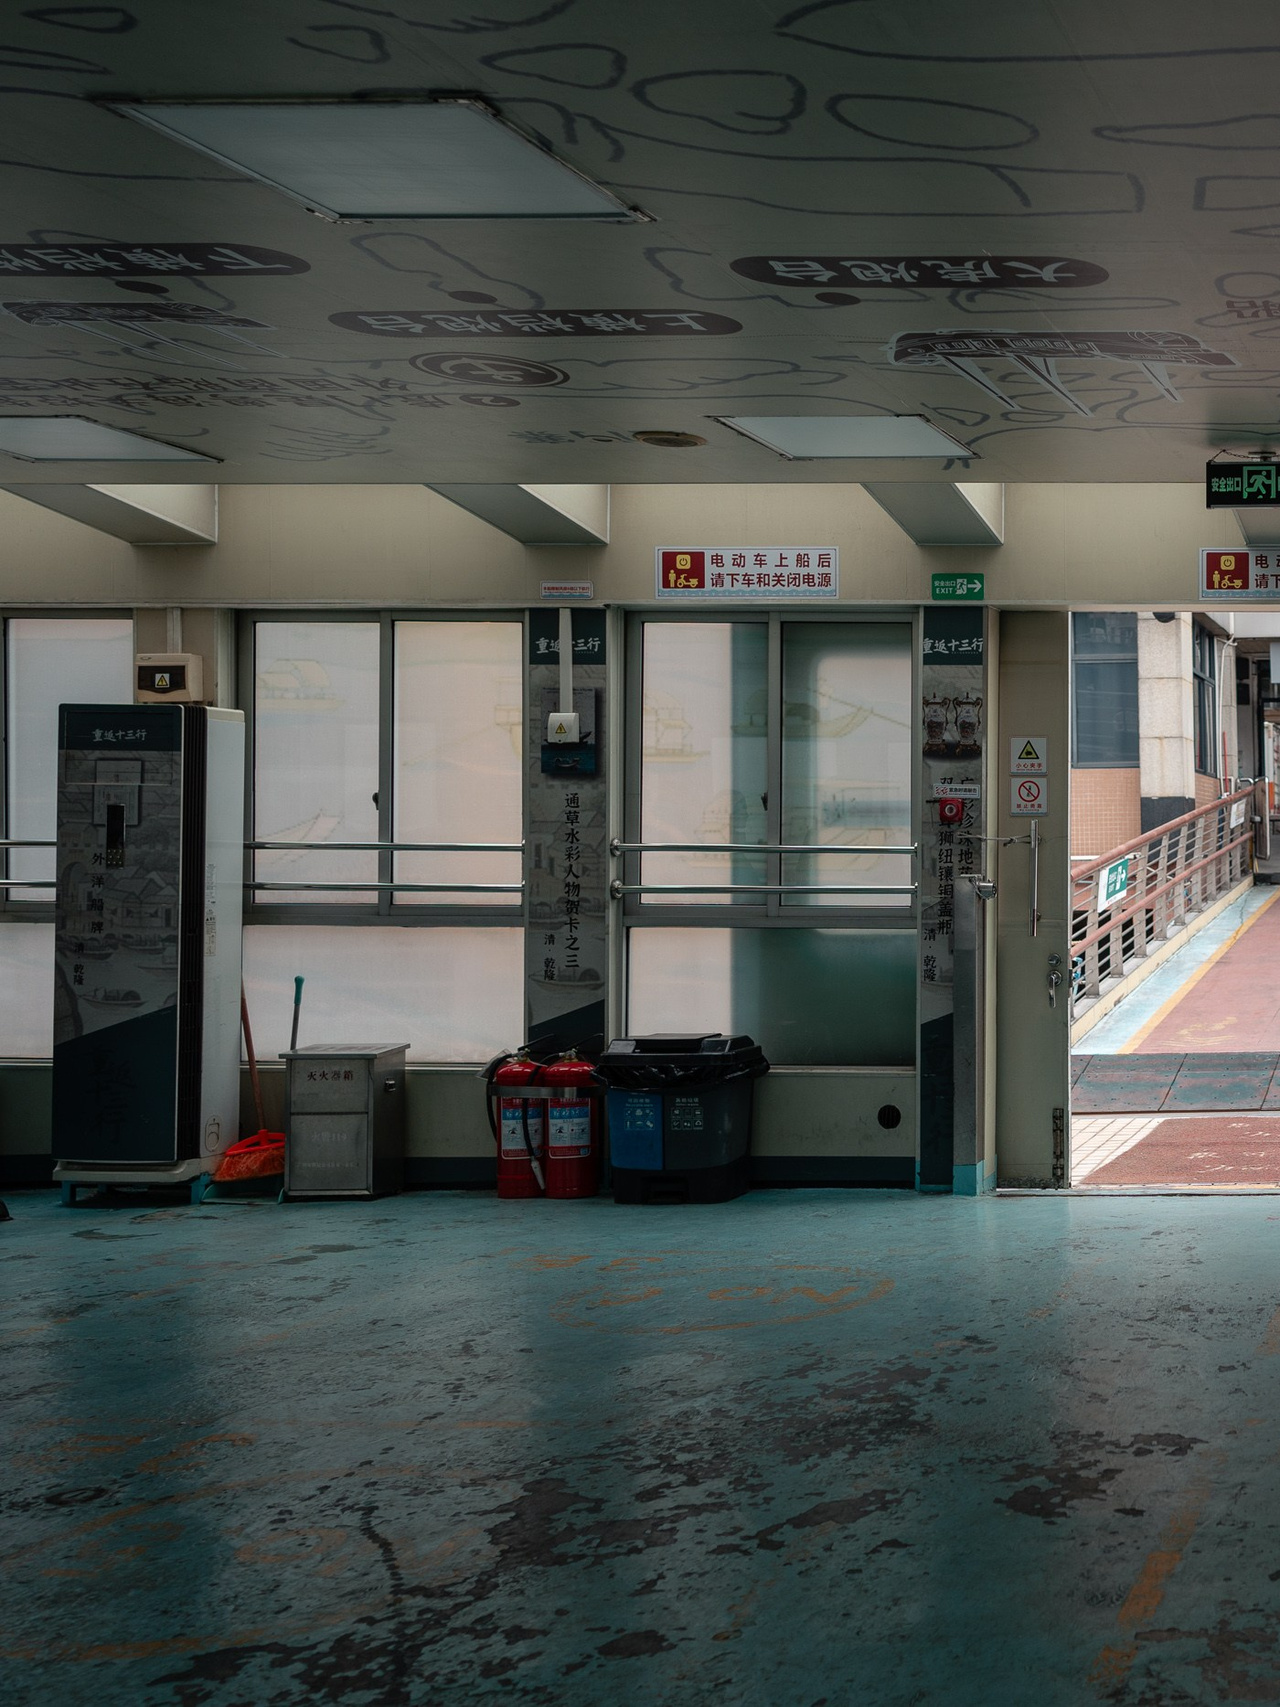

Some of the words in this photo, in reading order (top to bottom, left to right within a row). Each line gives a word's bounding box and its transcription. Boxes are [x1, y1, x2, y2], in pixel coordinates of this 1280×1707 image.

[768, 260, 1076, 283] 大虎炮台
[357, 313, 707, 333] 上横档炮台
[1211, 477, 1242, 492] 安全出口
[710, 553, 831, 569] 电动车上船后
[710, 572, 831, 589] 请下车和关闭电源
[935, 587, 954, 595] EXIT
[535, 637, 601, 654] 重返三行
[923, 637, 984, 654] 重返十三行
[564, 793, 580, 968] 通草水彩人物贺卡之三
[91, 852, 105, 935] 外洋船牌
[307, 1070, 354, 1081] 灭火器箱
